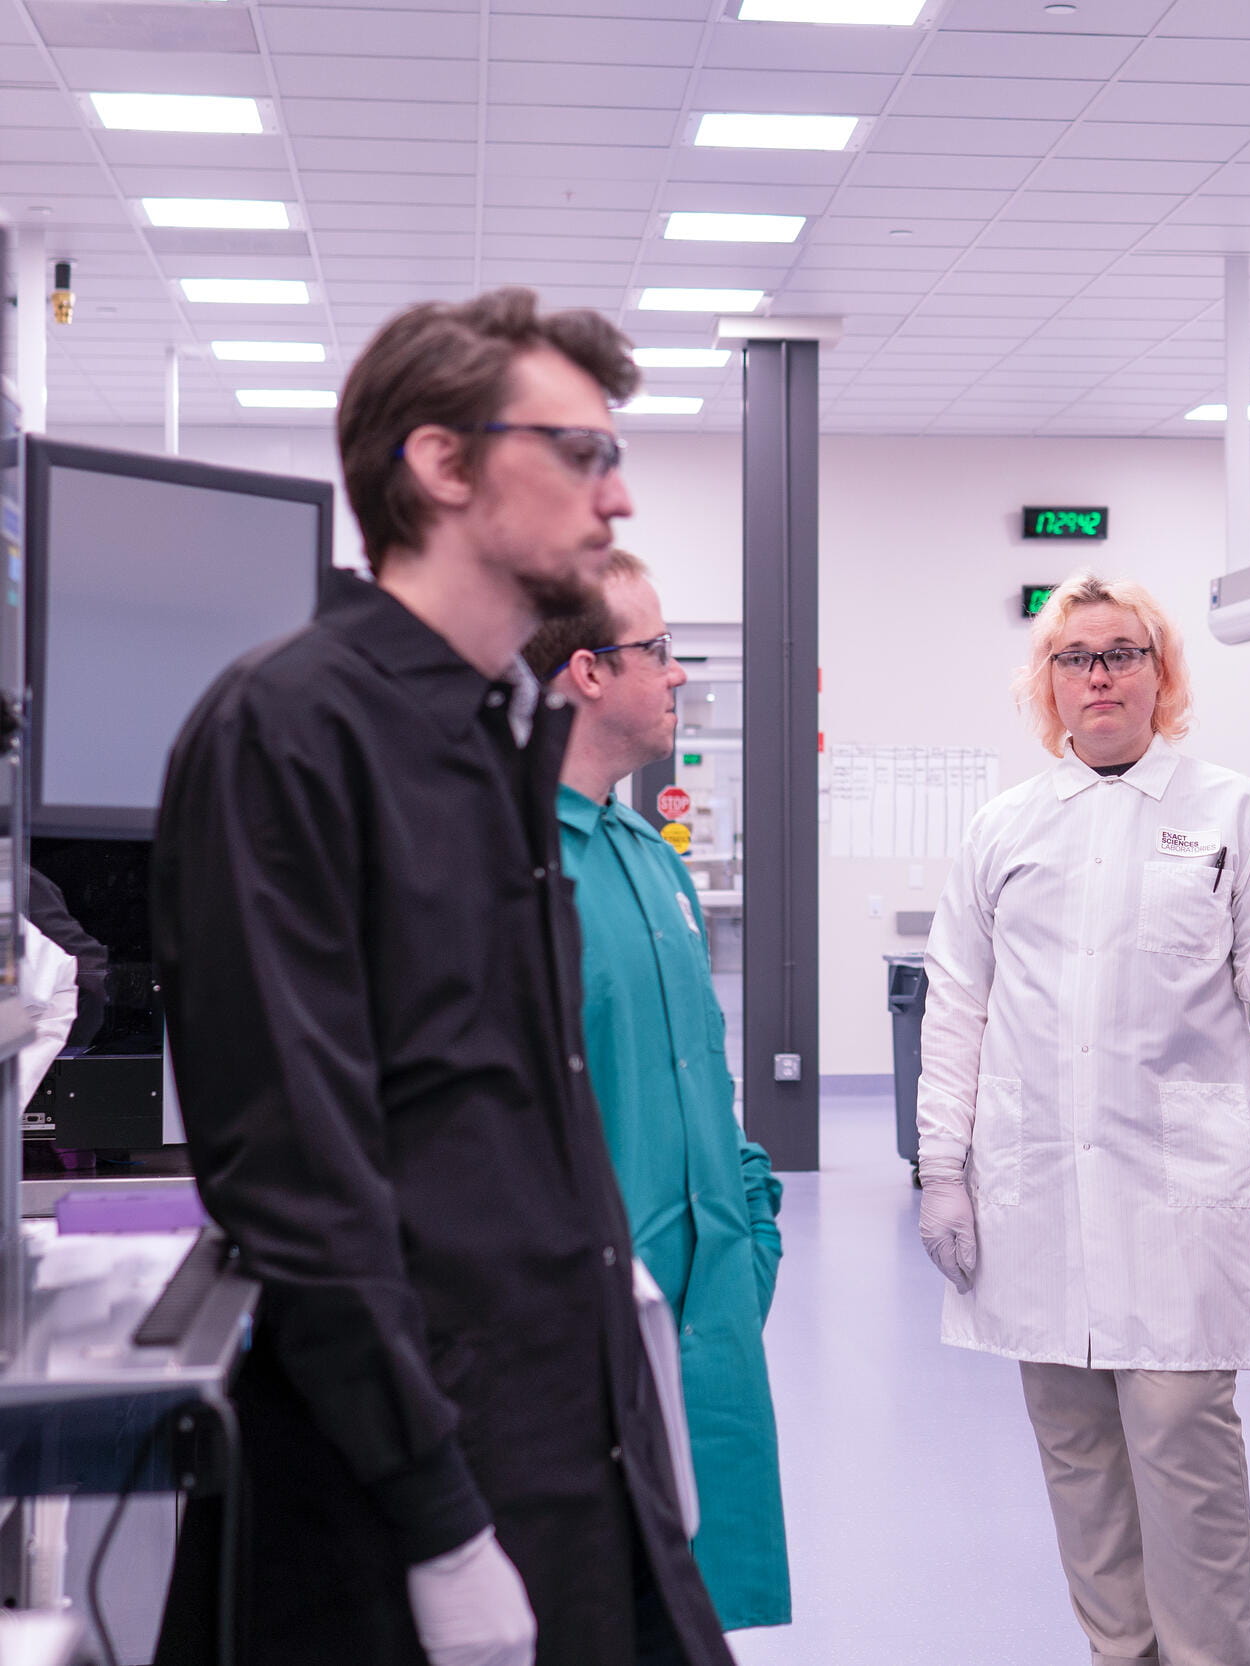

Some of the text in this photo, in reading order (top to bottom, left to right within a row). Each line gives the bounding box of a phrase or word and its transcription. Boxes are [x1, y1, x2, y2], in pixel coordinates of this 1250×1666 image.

[660, 795, 689, 811] STOP
[1162, 831, 1187, 841] EXACT
[1161, 838, 1199, 847] SCIENCES
[1161, 844, 1217, 853] LABORATORIES
